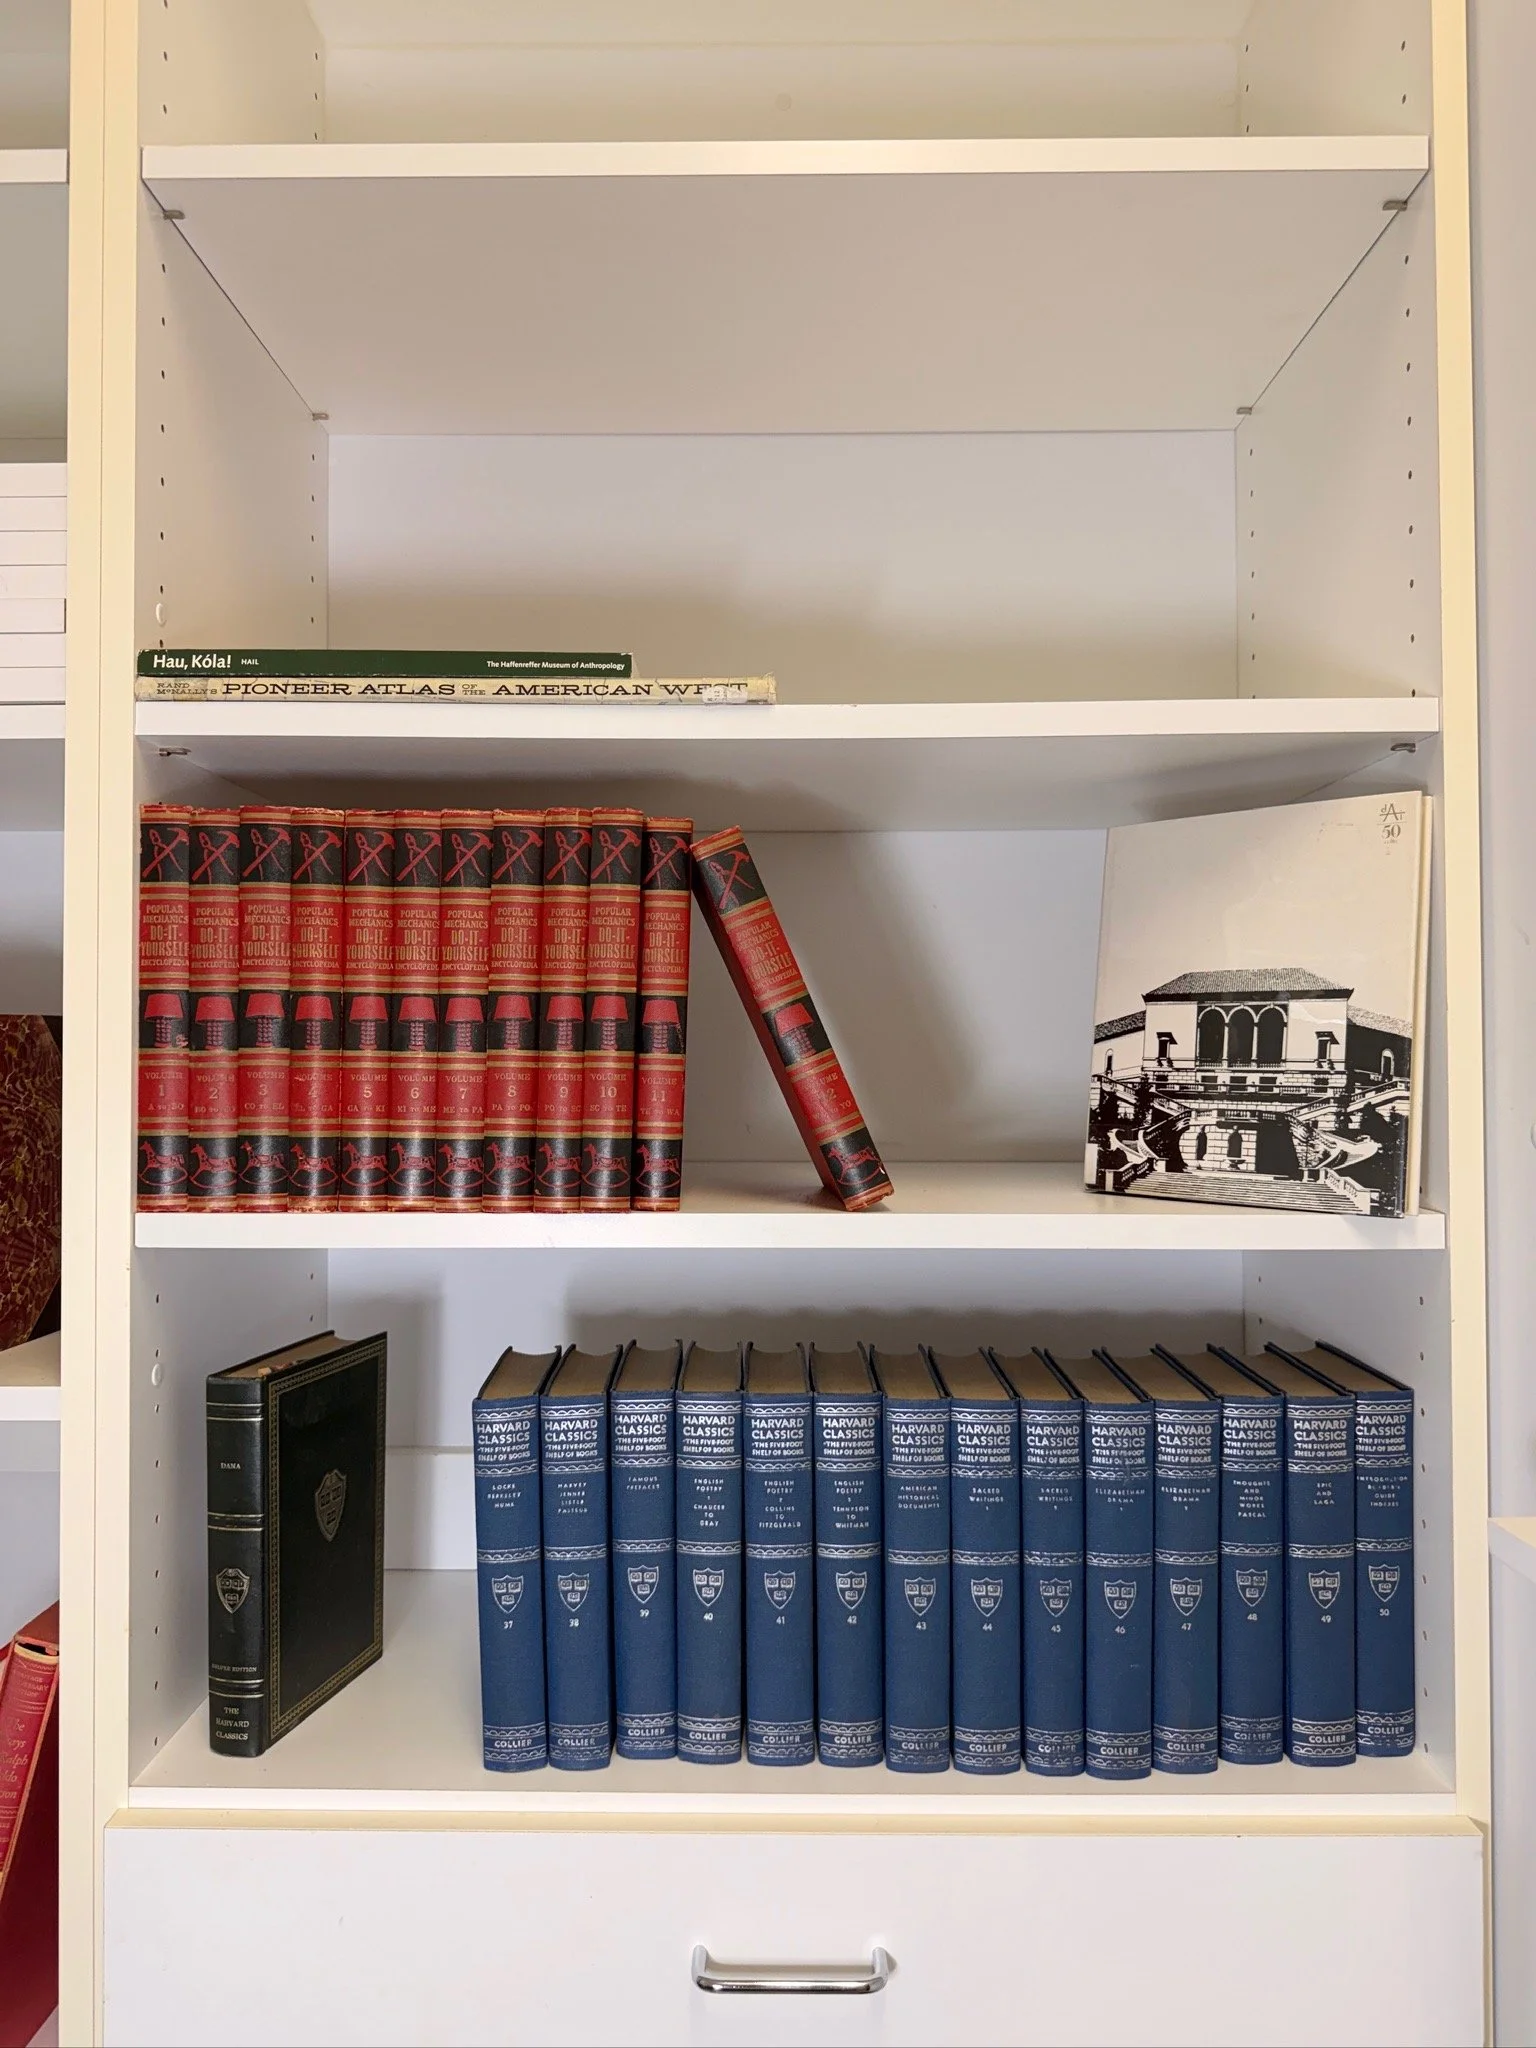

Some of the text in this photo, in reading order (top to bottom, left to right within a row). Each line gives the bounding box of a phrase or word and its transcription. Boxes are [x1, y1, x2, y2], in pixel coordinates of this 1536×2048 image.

[152, 654, 231, 670] Hau, Kóla!
[241, 658, 259, 666] HAIL
[487, 660, 625, 671] The Haffenreffer Museum of Anthropology
[222, 683, 456, 696] PIONEER ATLAS
[492, 684, 748, 696] AMERICAN WET
[1382, 824, 1401, 838] 50
[146, 905, 184, 914] POPULAR
[248, 904, 286, 914] POPULAR
[352, 908, 389, 917] POPULAR
[400, 910, 437, 918] POPULAR
[498, 908, 534, 916] POPULAR
[595, 907, 631, 916] POPULAR
[448, 910, 484, 919] POPULAR
[444, 920, 488, 929] MECHANICS
[494, 918, 538, 926] MECHANICS
[592, 917, 636, 926] MECHANICS
[495, 1072, 531, 1080] VOLUME
[548, 1073, 582, 1082] VOLUME
[591, 1073, 626, 1081] VOLUME
[159, 1084, 165, 1096] 1
[209, 1087, 219, 1099] 2
[259, 1084, 268, 1096] 3
[363, 1086, 372, 1098] 5
[410, 1086, 420, 1099] 6
[459, 1087, 468, 1100] 7
[508, 1085, 517, 1097] 8
[560, 1086, 568, 1098] 9
[600, 1086, 618, 1098] 10
[652, 1090, 666, 1102] 11
[614, 1414, 667, 1424] HARVARD
[682, 1416, 735, 1426] HARVARD
[752, 1418, 804, 1429] HARVARD
[823, 1418, 876, 1428] HARVARD
[1223, 1418, 1276, 1429] HARVARD
[1356, 1415, 1406, 1425] HARVARD
[477, 1420, 530, 1434] HARVARD
[544, 1419, 598, 1431] HARVARD
[892, 1424, 945, 1434] HARVARD
[957, 1424, 1011, 1434] HARVARD
[1158, 1424, 1212, 1434] HARVARD
[1294, 1420, 1347, 1430] HARVARD
[615, 1425, 667, 1436] CLASSICS
[683, 1427, 735, 1437] CLASSICS
[752, 1430, 804, 1440] CLASSICS
[823, 1429, 875, 1439] CLASSICS
[1026, 1425, 1080, 1436] HARVARD
[1092, 1426, 1146, 1436] HARVARD
[1224, 1429, 1276, 1440] CLASSICS
[1356, 1426, 1406, 1436] CLASSICS
[478, 1432, 530, 1444] CLASSICS
[545, 1431, 598, 1442] CLASSICS
[892, 1435, 945, 1445] CLASSICS
[958, 1436, 1010, 1446] CLASSICS
[1026, 1436, 1080, 1446] CLASSICS
[1158, 1435, 1212, 1446] CLASSICS
[1294, 1432, 1347, 1442] CLASSICS
[1092, 1437, 1146, 1448] CLASSICS
[640, 1608, 650, 1618] 39
[703, 1612, 714, 1621] 40
[1247, 1612, 1258, 1621] 48
[1379, 1608, 1390, 1617] 50
[569, 1618, 579, 1628] 38
[776, 1616, 785, 1624] 41
[847, 1615, 858, 1624] 42
[1321, 1615, 1332, 1624] 49
[504, 1620, 514, 1630] 37
[916, 1622, 926, 1630] 43
[982, 1624, 992, 1632] 44
[1050, 1624, 1061, 1633] 45
[1114, 1626, 1126, 1634] 46
[1182, 1622, 1192, 1631] 47
[224, 1707, 240, 1715] THE
[216, 1718, 250, 1728] HARVARD
[216, 1731, 248, 1740] CLASSICS
[628, 1728, 664, 1737] COLLIER
[1368, 1726, 1405, 1735] COLLIER
[558, 1737, 596, 1746] COLLIER
[690, 1732, 726, 1741] COLLIER
[763, 1735, 800, 1744] COLLIER
[834, 1735, 872, 1744] COLLIER
[1234, 1732, 1272, 1741] COLLIER
[1308, 1734, 1346, 1744] COLLIER
[494, 1738, 532, 1748] COLLIER
[902, 1741, 940, 1750] COLLIER
[969, 1744, 1008, 1752] COLLIER
[1166, 1742, 1206, 1752] COLLIER
[1100, 1746, 1138, 1756] COLLIER
